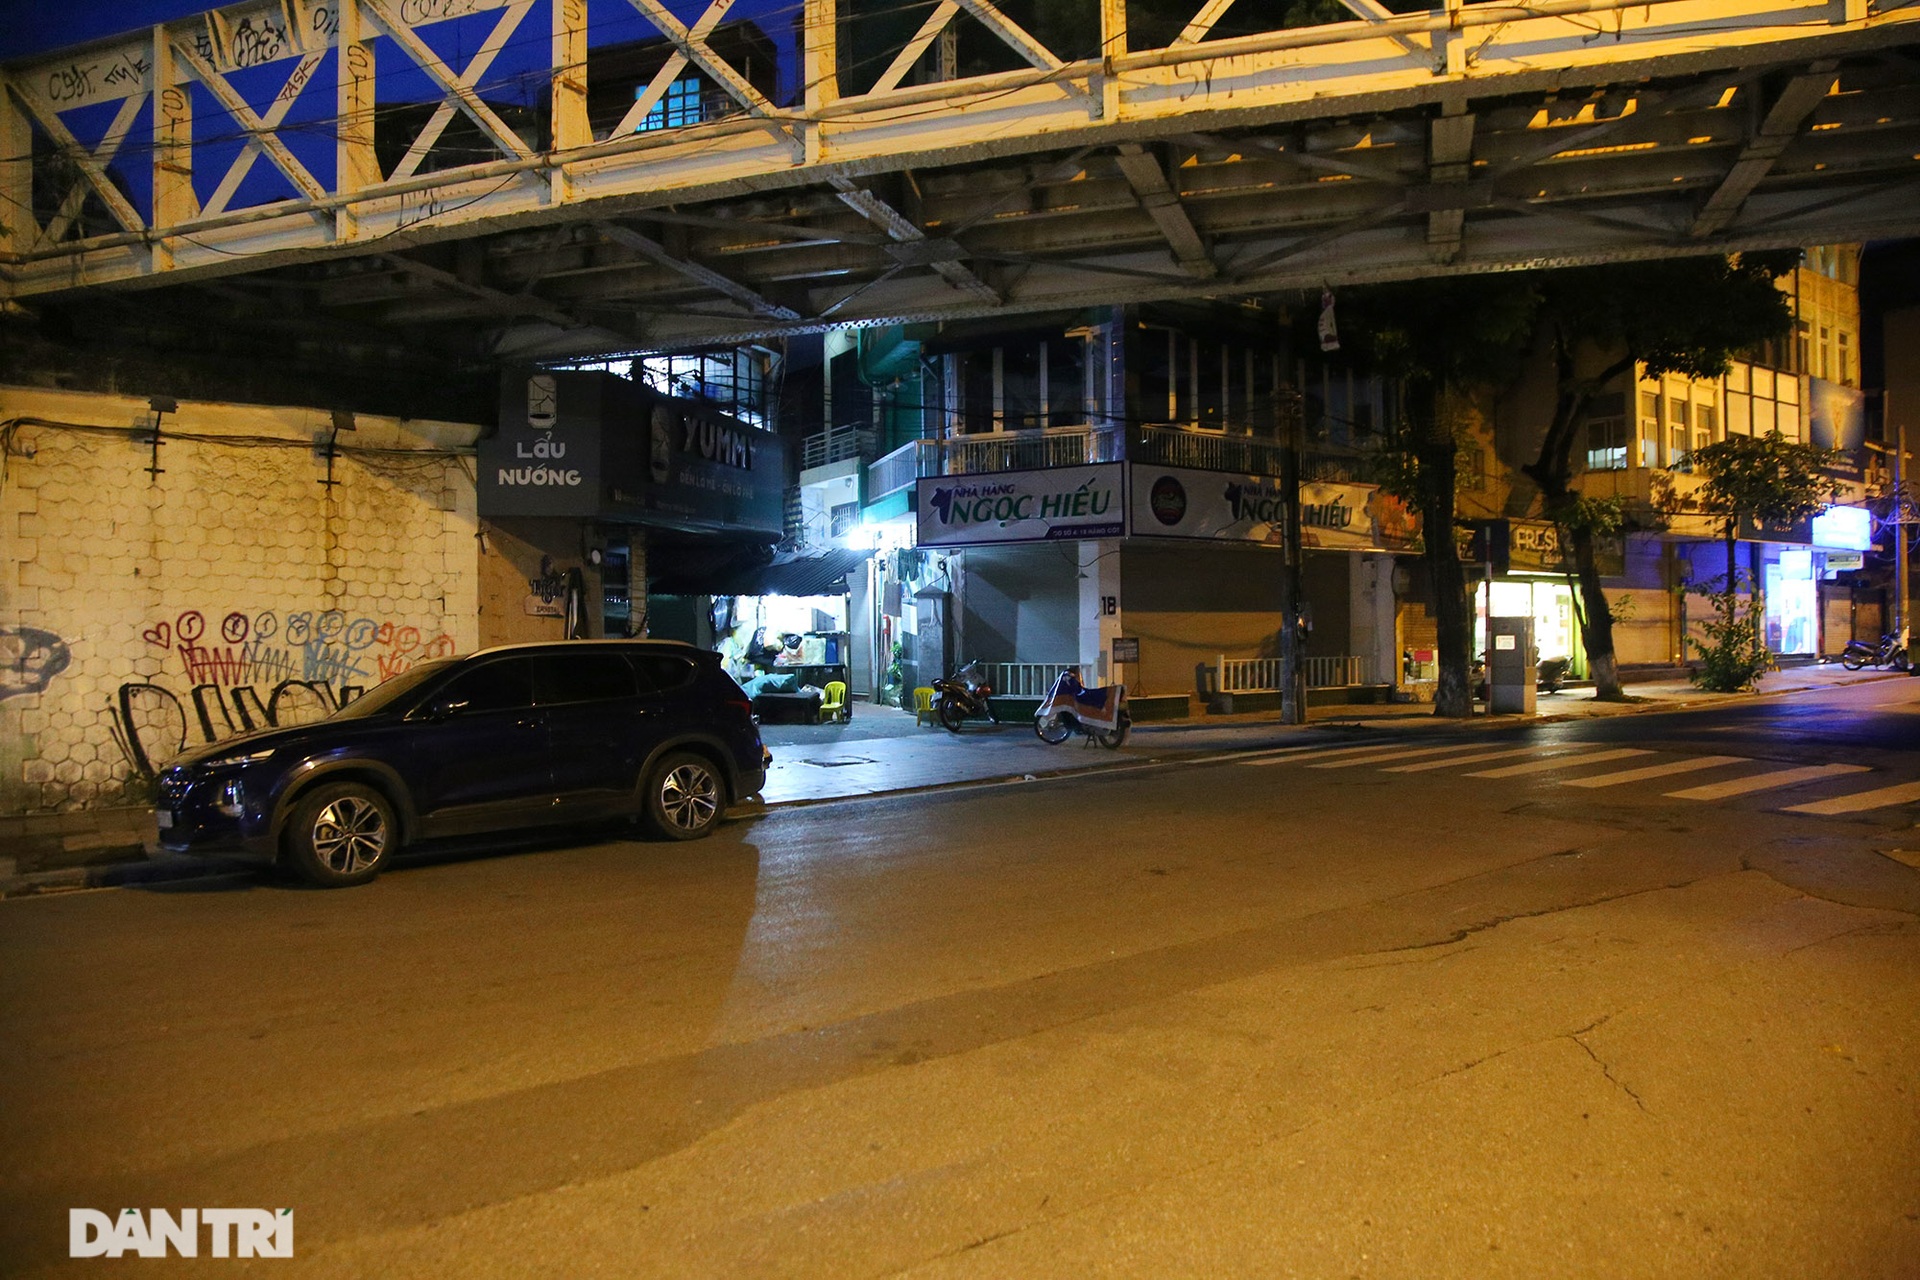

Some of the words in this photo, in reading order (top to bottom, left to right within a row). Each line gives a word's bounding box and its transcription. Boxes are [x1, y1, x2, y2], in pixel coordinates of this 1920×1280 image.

[516, 430, 566, 459] LẨU
[498, 462, 582, 486] NƯỚNG
[950, 494, 1033, 528] NGỌC
[1040, 477, 1111, 519] HIẾU
[953, 484, 977, 498] NHÀ
[981, 482, 1015, 496] HÀNG
[1308, 494, 1352, 528] HIẾU
[1101, 596, 1116, 615] 18
